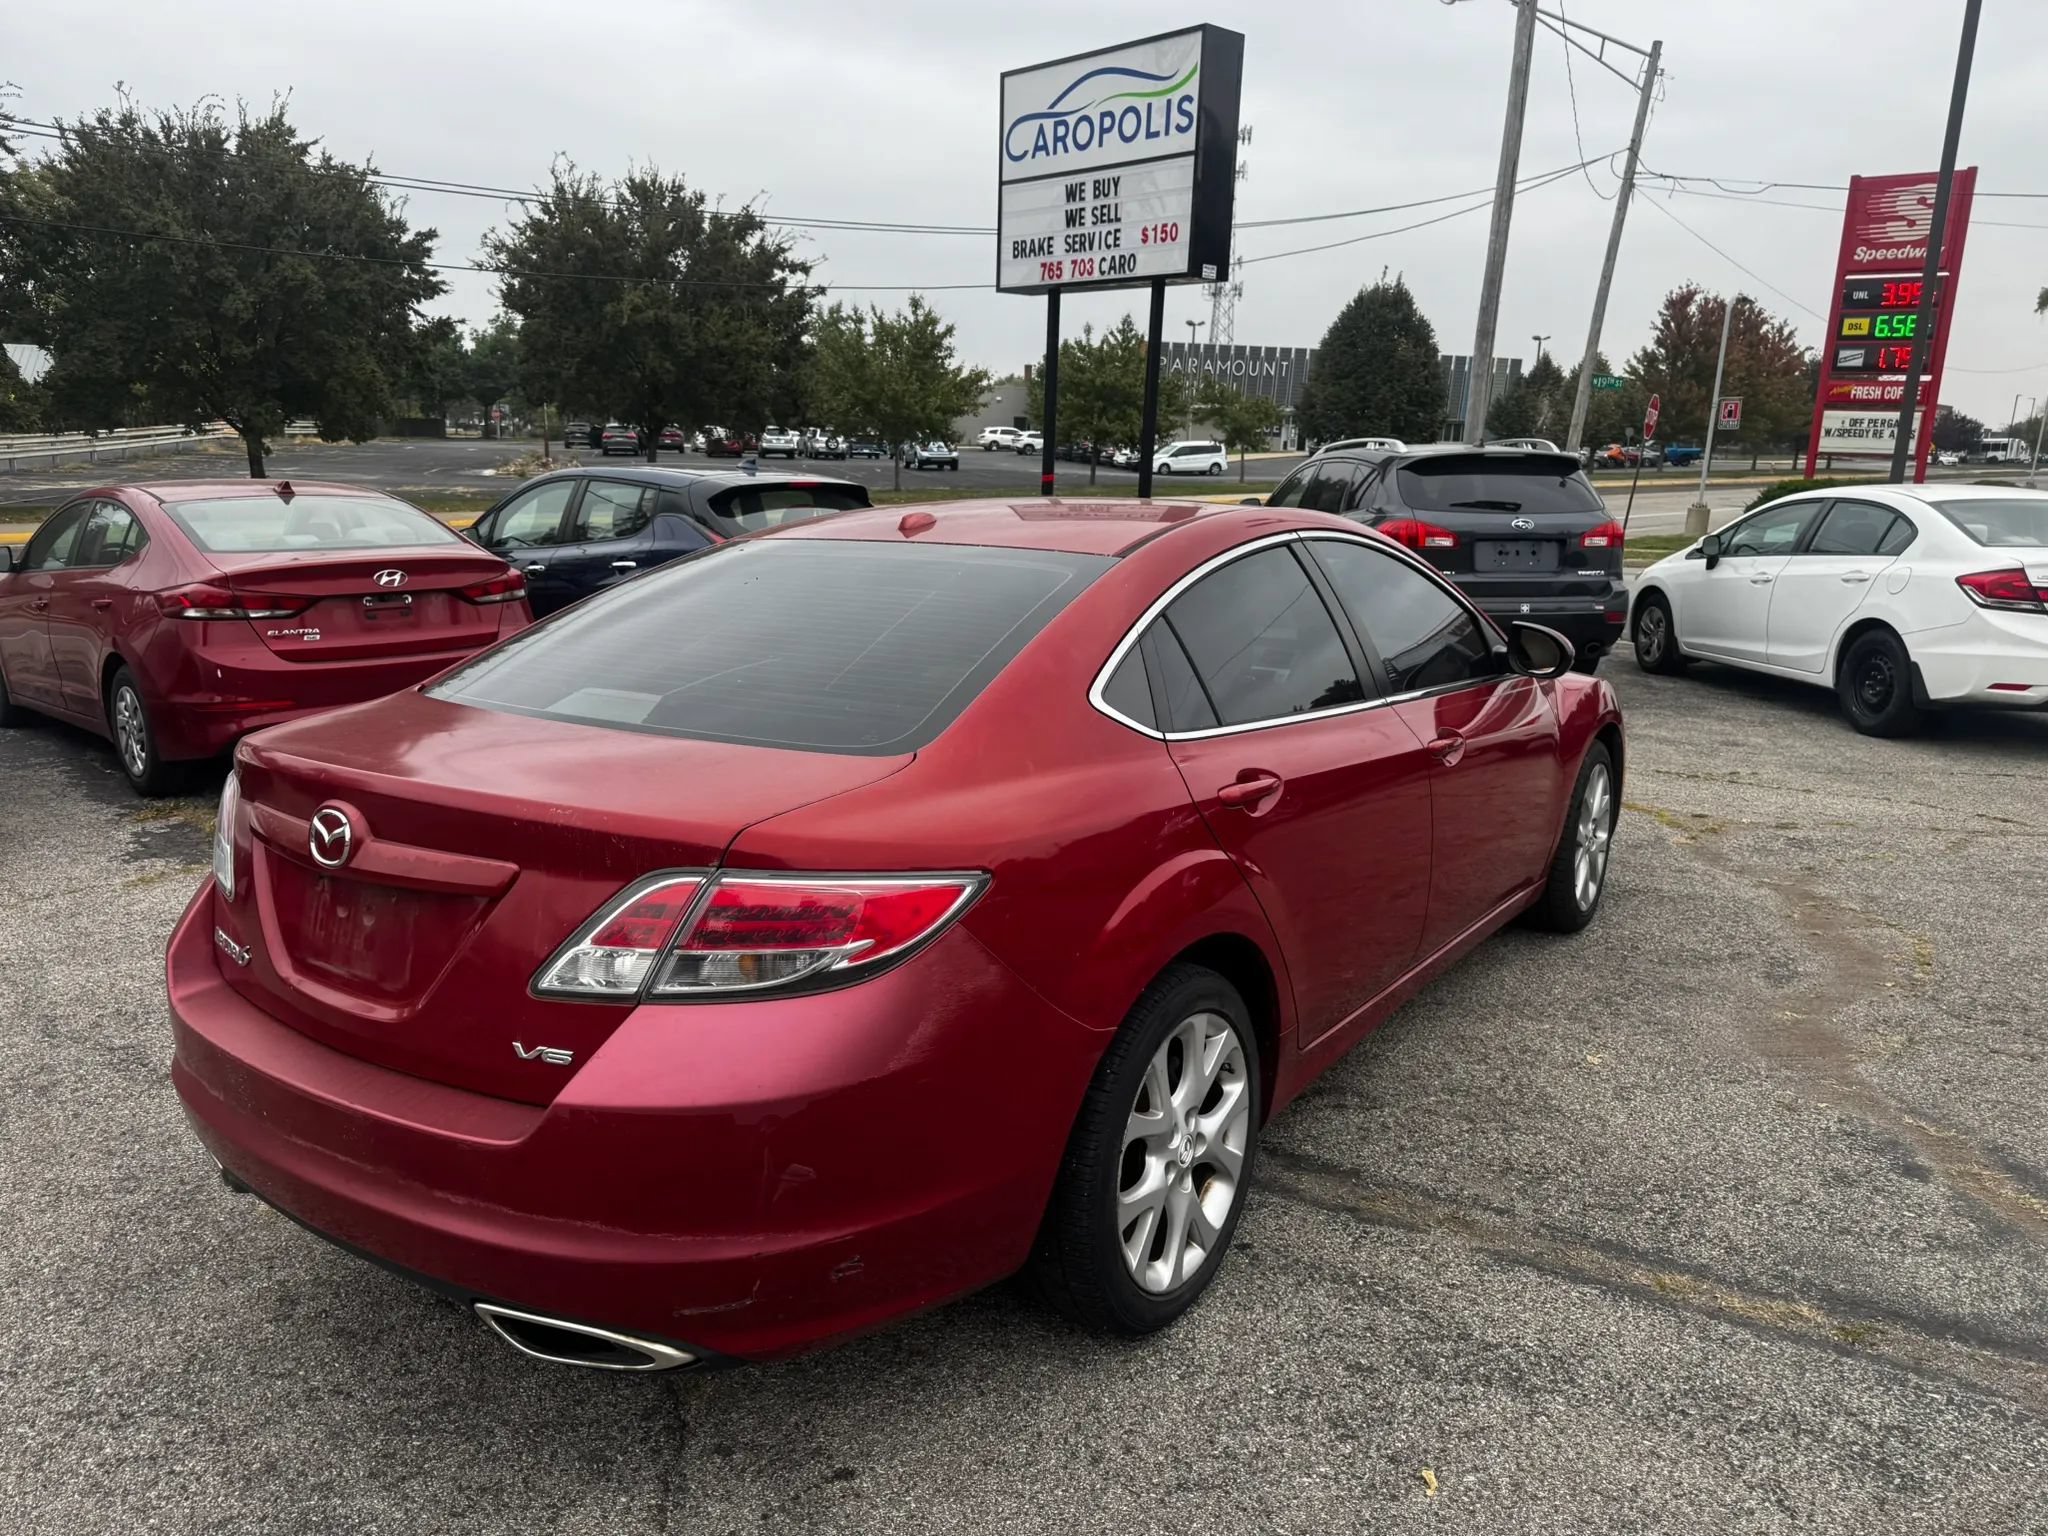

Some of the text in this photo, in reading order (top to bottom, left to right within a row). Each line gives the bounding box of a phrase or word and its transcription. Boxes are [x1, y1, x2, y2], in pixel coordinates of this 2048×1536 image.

[1005, 94, 1194, 162] CAROPOLIS
[1065, 176, 1121, 204] WE BUY
[1065, 203, 1121, 229] WE SELL
[1012, 223, 1179, 259] BRAKE SERVICE $150
[1853, 245, 1945, 263] Speedw
[1040, 253, 1136, 282] 765 703 CARO
[1853, 291, 1869, 299] UNL
[1159, 356, 1289, 377] PARAMOUNT
[1598, 377, 1615, 387] 19TH
[1615, 379, 1623, 388] ST
[1850, 386, 1881, 399] FRESH
[1884, 386, 1922, 399] COF
[1824, 427, 1871, 438] W/SPEEDY
[1849, 418, 1864, 428] OFF
[267, 628, 320, 636] ELANTRA
[512, 1040, 574, 1066] V6
